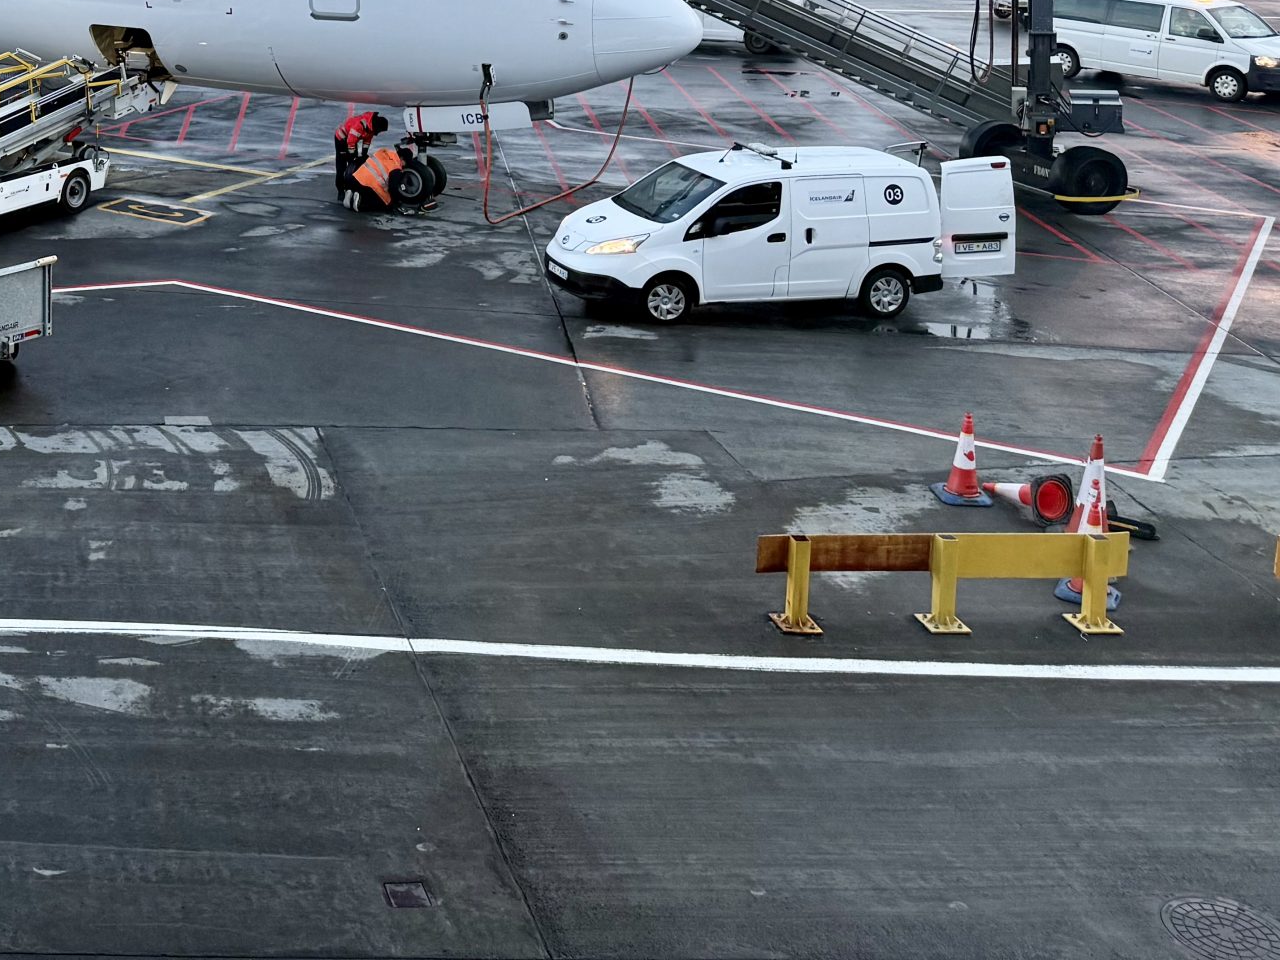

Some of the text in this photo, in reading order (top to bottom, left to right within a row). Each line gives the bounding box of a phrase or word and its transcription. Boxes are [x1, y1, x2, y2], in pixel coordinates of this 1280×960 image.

[461, 113, 484, 125] ICB
[886, 188, 902, 200] 03
[962, 243, 999, 252] VE A83
